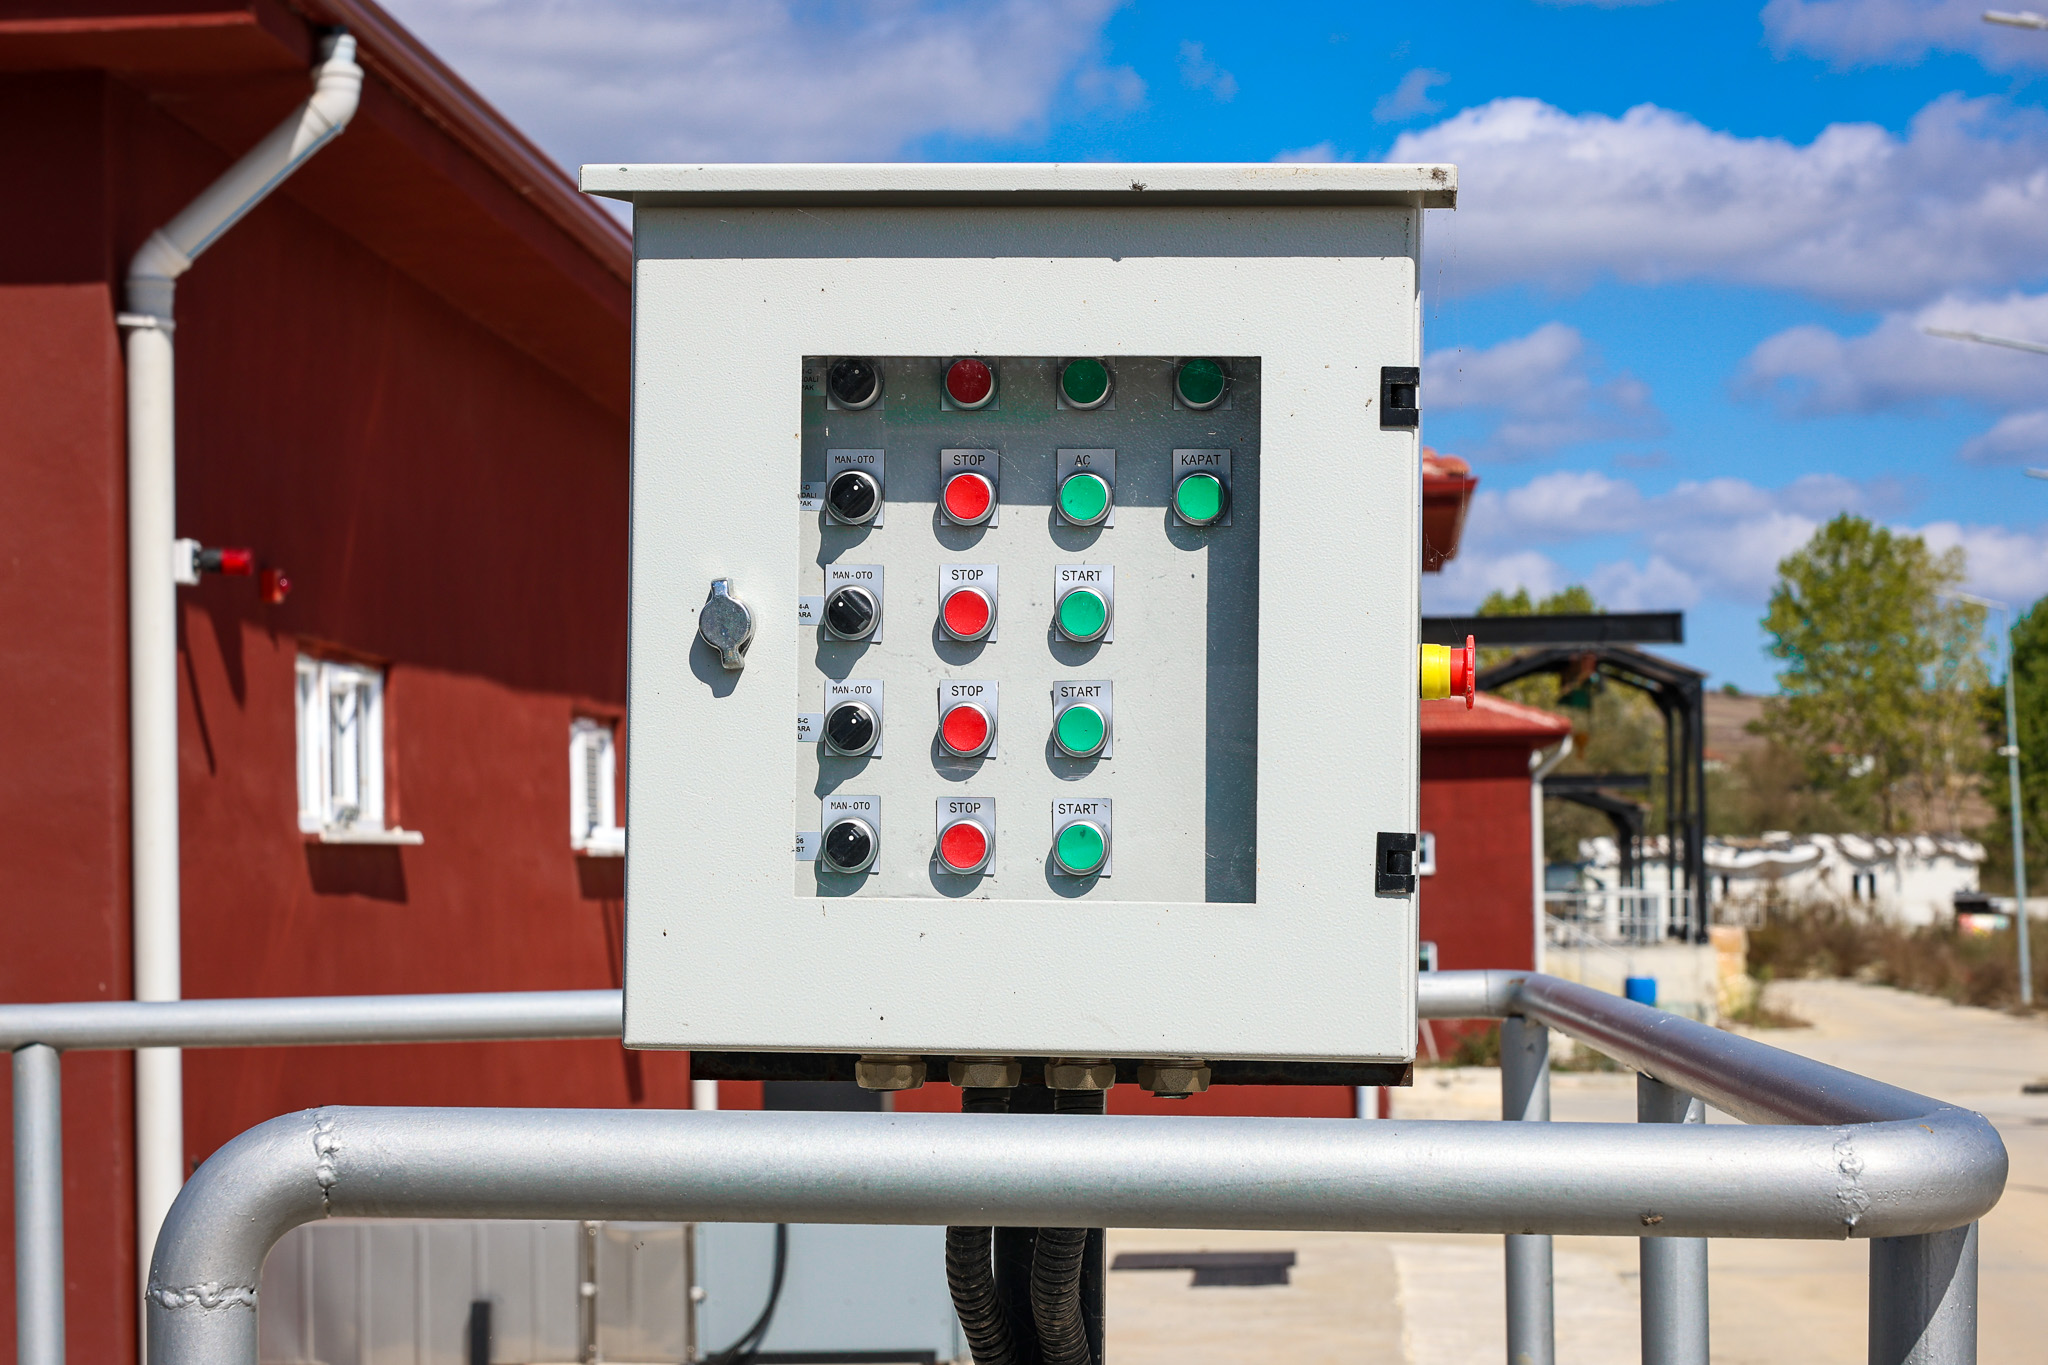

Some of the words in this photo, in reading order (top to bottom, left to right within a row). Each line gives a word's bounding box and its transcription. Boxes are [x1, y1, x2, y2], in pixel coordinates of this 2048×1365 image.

[834, 455, 875, 464] MAN-OTO
[953, 454, 986, 466] STOP
[1074, 454, 1091, 468] AÇ
[1181, 454, 1222, 466] KAPAT
[832, 570, 873, 580] MAN-OTO
[951, 569, 984, 581] STOP
[1061, 569, 1102, 582] START
[832, 685, 872, 695] MAN-OTO
[951, 685, 984, 697] STOP
[1060, 685, 1102, 698] START
[830, 801, 871, 811] MAN-OTO
[949, 801, 981, 814] STOP
[1058, 803, 1099, 815] START
